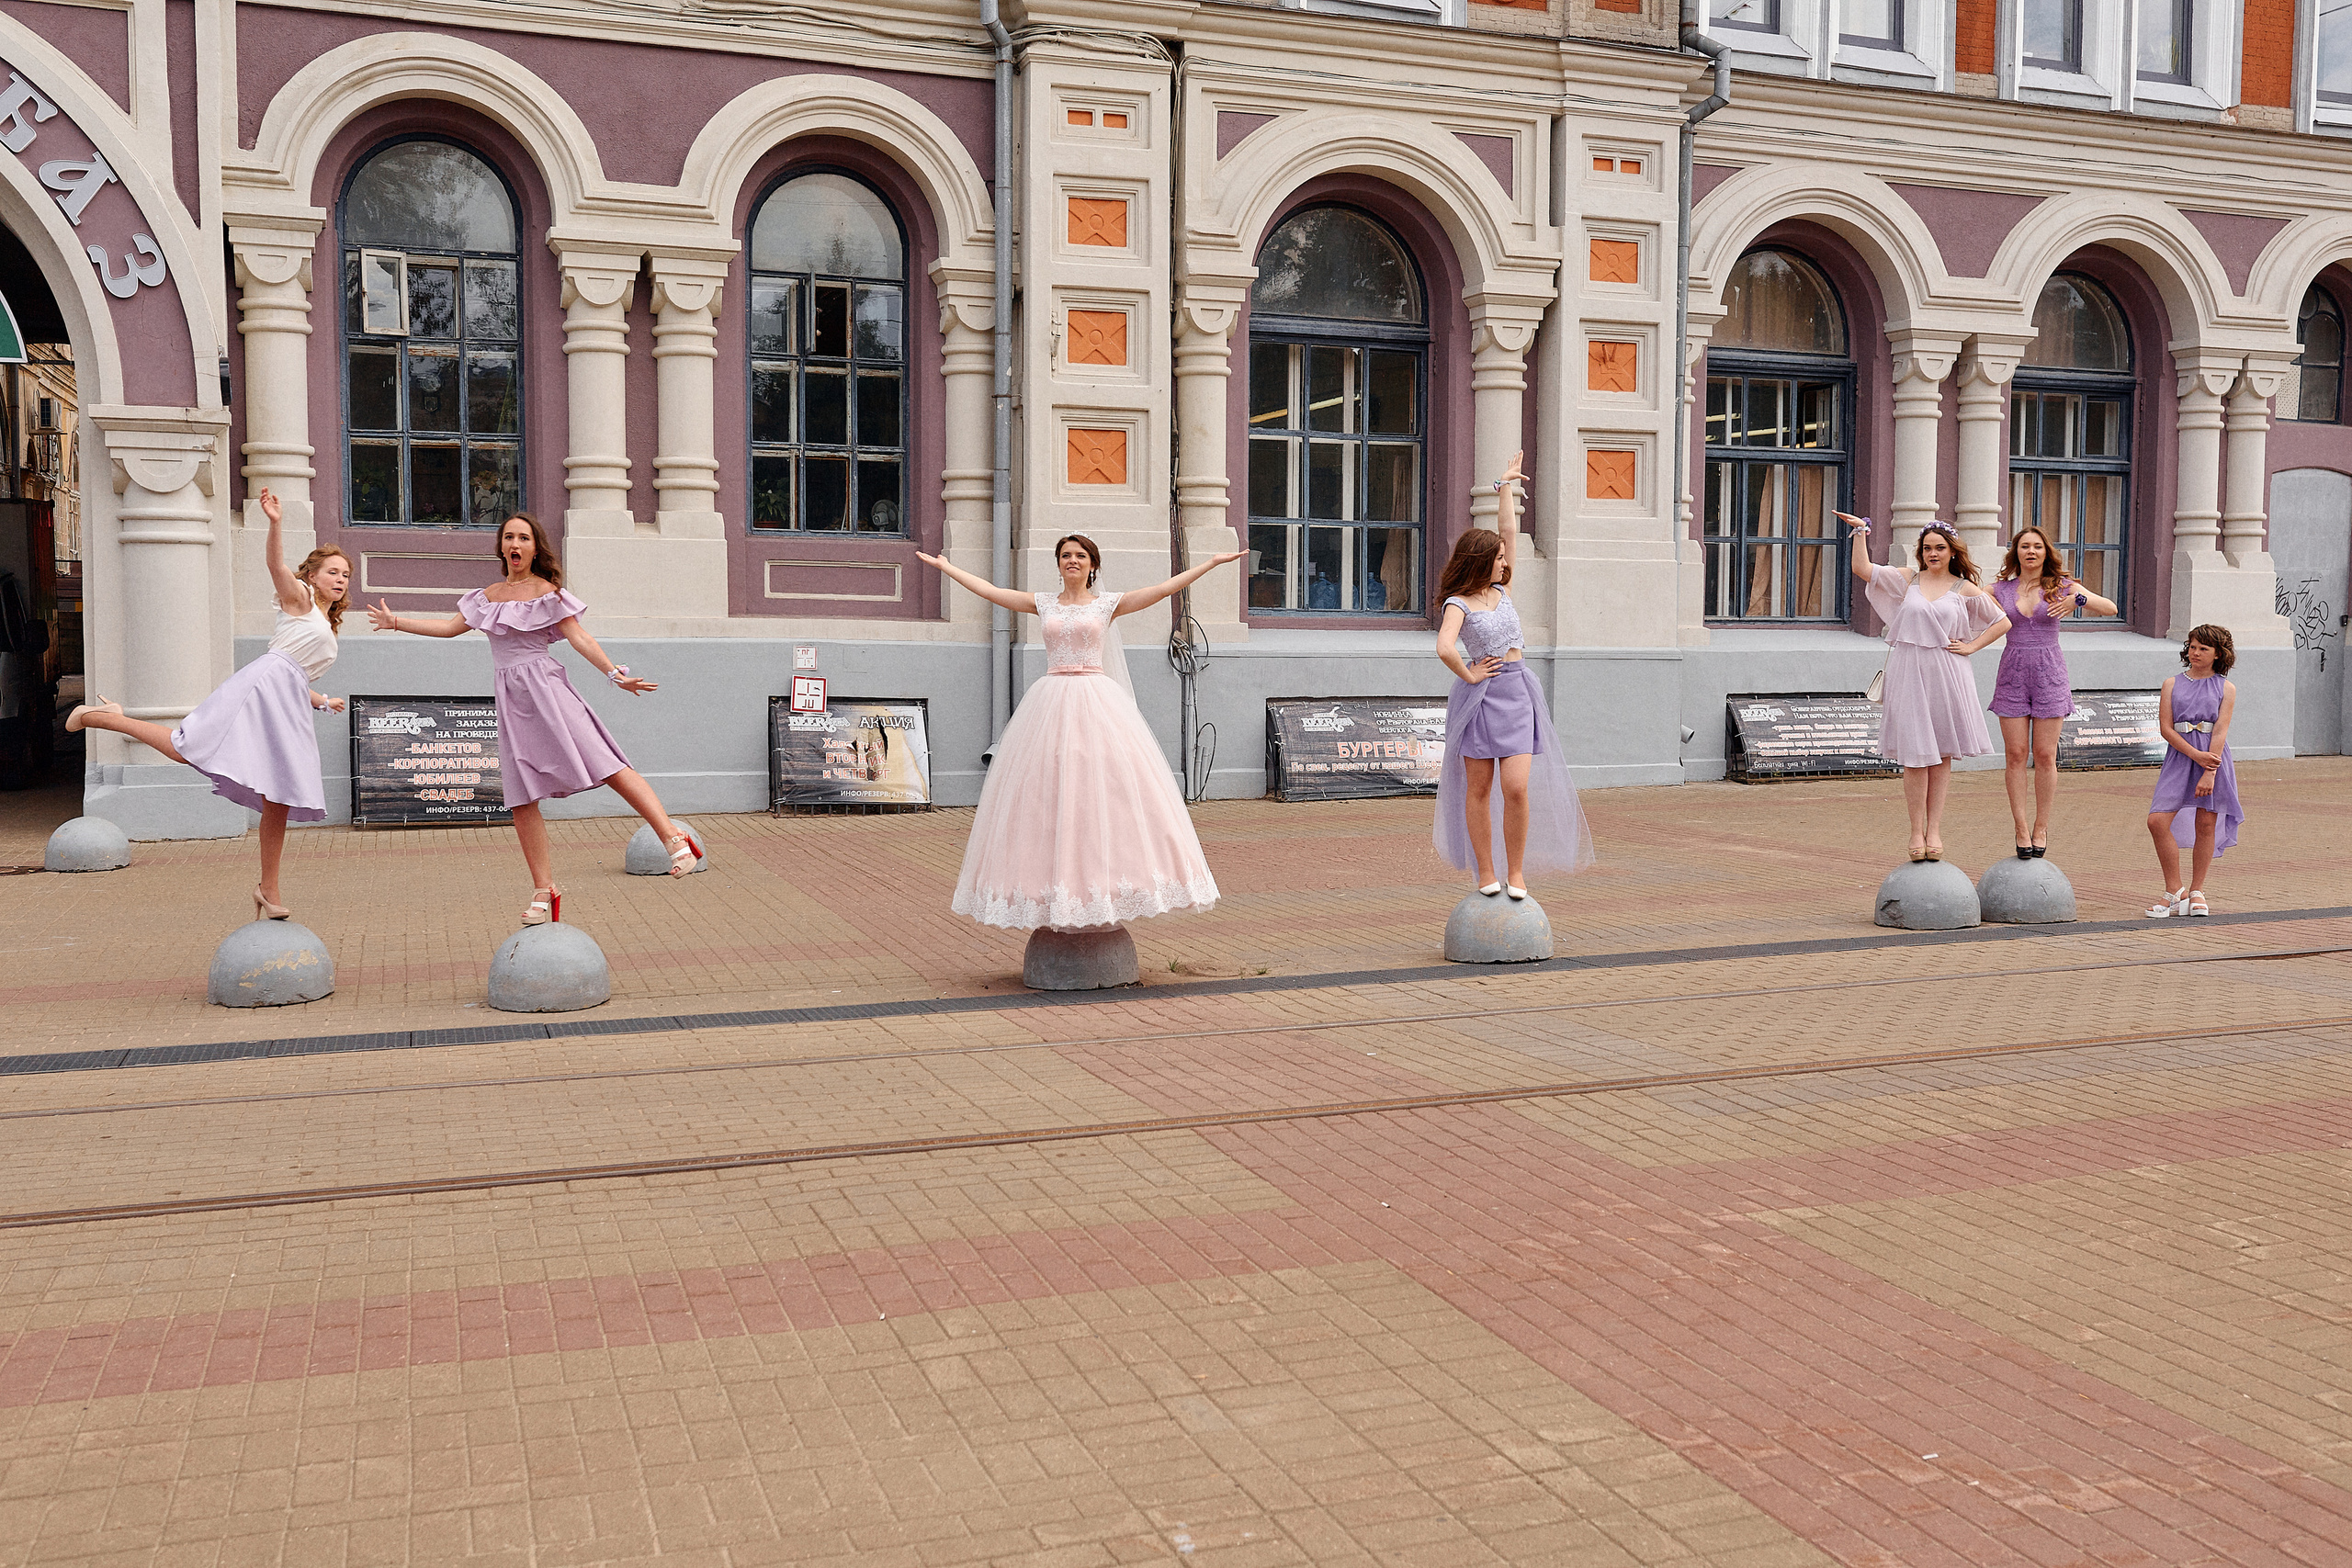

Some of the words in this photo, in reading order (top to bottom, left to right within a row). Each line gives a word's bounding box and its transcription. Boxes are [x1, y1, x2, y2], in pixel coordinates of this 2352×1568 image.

[858, 716, 915, 729] АКЦИЯ
[435, 730, 451, 739] НА
[404, 742, 482, 754] -БАНКЕТОВ
[1337, 741, 1425, 759] БУРГЕРЫ
[388, 758, 499, 769] -КОРПОРАТИВОВ
[1291, 761, 1305, 773] По
[1370, 761, 1382, 771] от
[407, 773, 481, 784] -ЮБИЛЕЕВ
[822, 770, 831, 779] и
[414, 788, 475, 803] -СВАДЕБ
[425, 806, 481, 814] ИНФО/РЕЗЕРВ:
